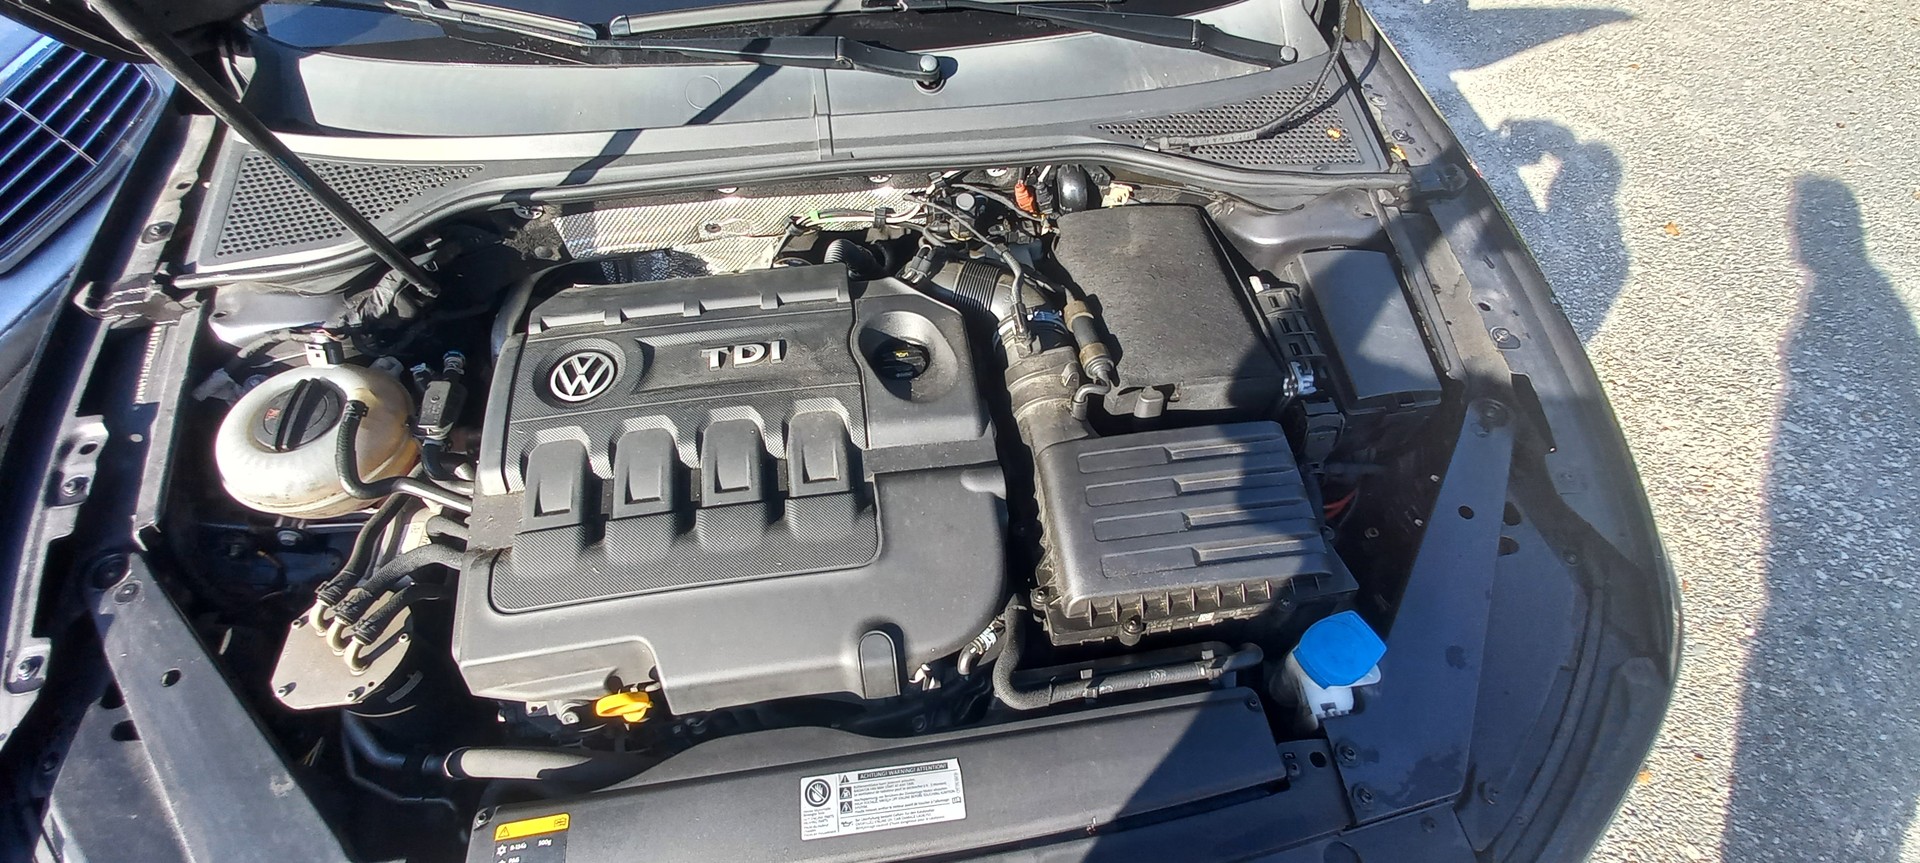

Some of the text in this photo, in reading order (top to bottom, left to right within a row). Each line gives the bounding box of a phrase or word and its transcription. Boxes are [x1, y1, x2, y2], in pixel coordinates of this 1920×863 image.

[701, 339, 784, 371] TDI
[550, 351, 615, 402] VW
[888, 767, 916, 776] WARNING!
[916, 763, 947, 772] ATTENTION!
